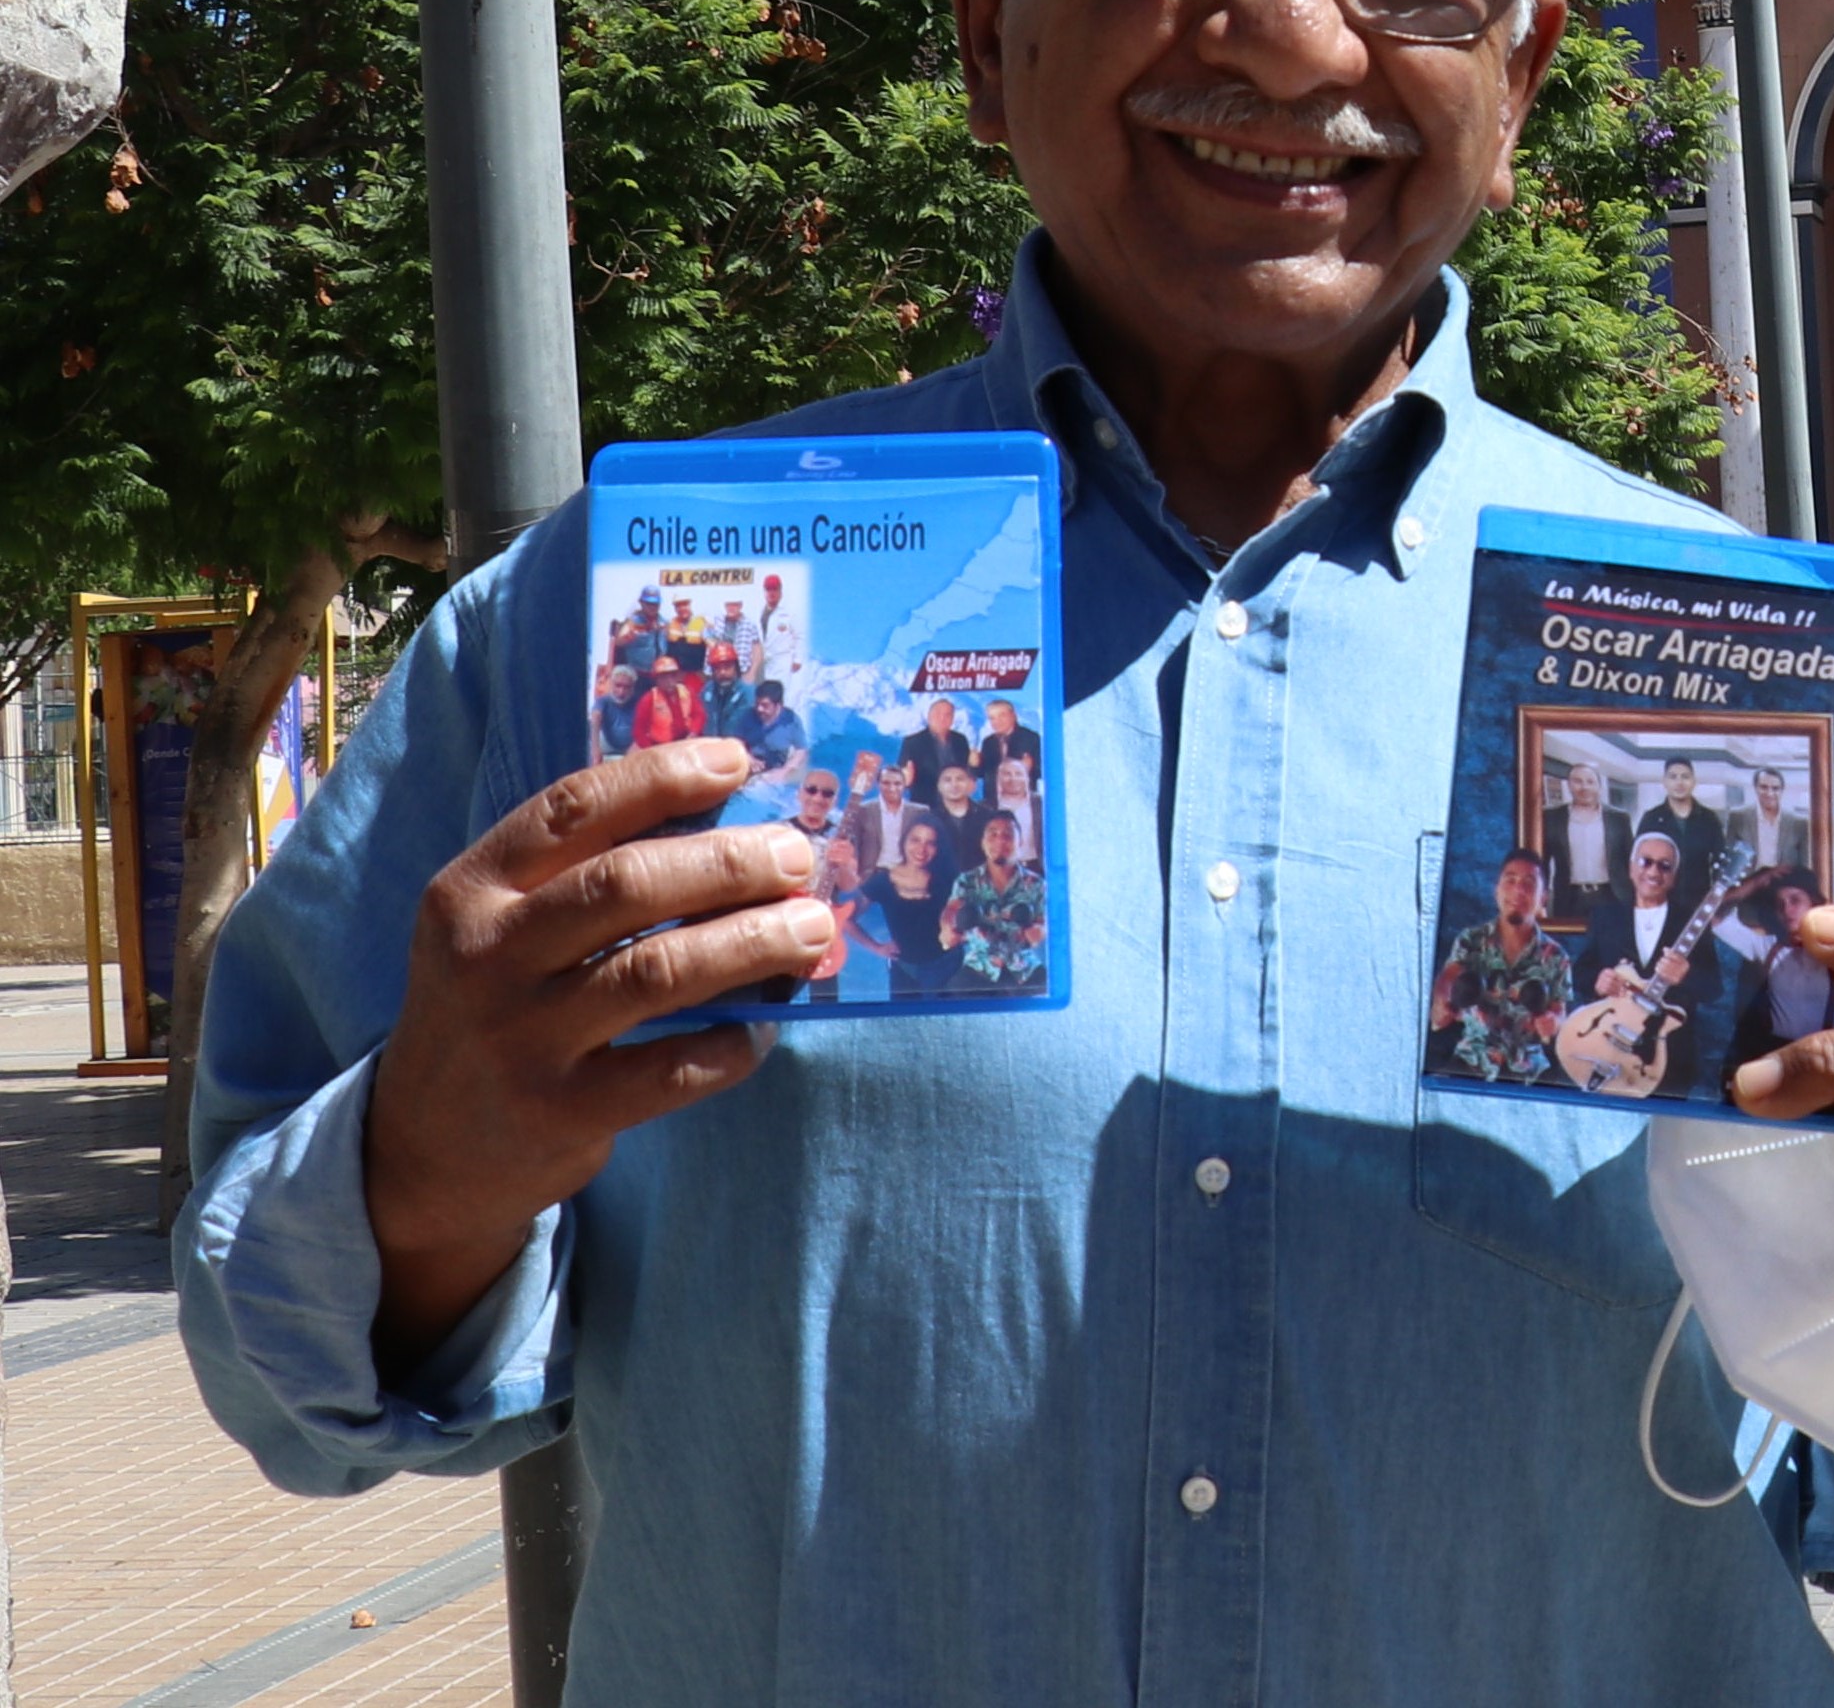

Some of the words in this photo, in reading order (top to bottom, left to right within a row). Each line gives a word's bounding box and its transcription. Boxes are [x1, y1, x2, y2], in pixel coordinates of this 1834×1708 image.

[627, 516, 698, 556] Chile
[707, 524, 740, 555] en
[750, 523, 801, 555] una
[811, 511, 926, 554] Canción
[664, 571, 683, 586] LA
[1544, 579, 1574, 600] La
[1691, 599, 1722, 619] mi
[1729, 600, 1786, 626] Vida
[1541, 613, 1653, 659] Oscar
[924, 674, 935, 691] &
[937, 673, 972, 690] Dixon
[974, 673, 998, 689] Mix
[925, 652, 965, 673] Oscar
[966, 650, 1032, 676] Arriagada
[1537, 655, 1560, 685] &
[1570, 659, 1663, 697] Dixon
[1672, 670, 1731, 704] Mix
